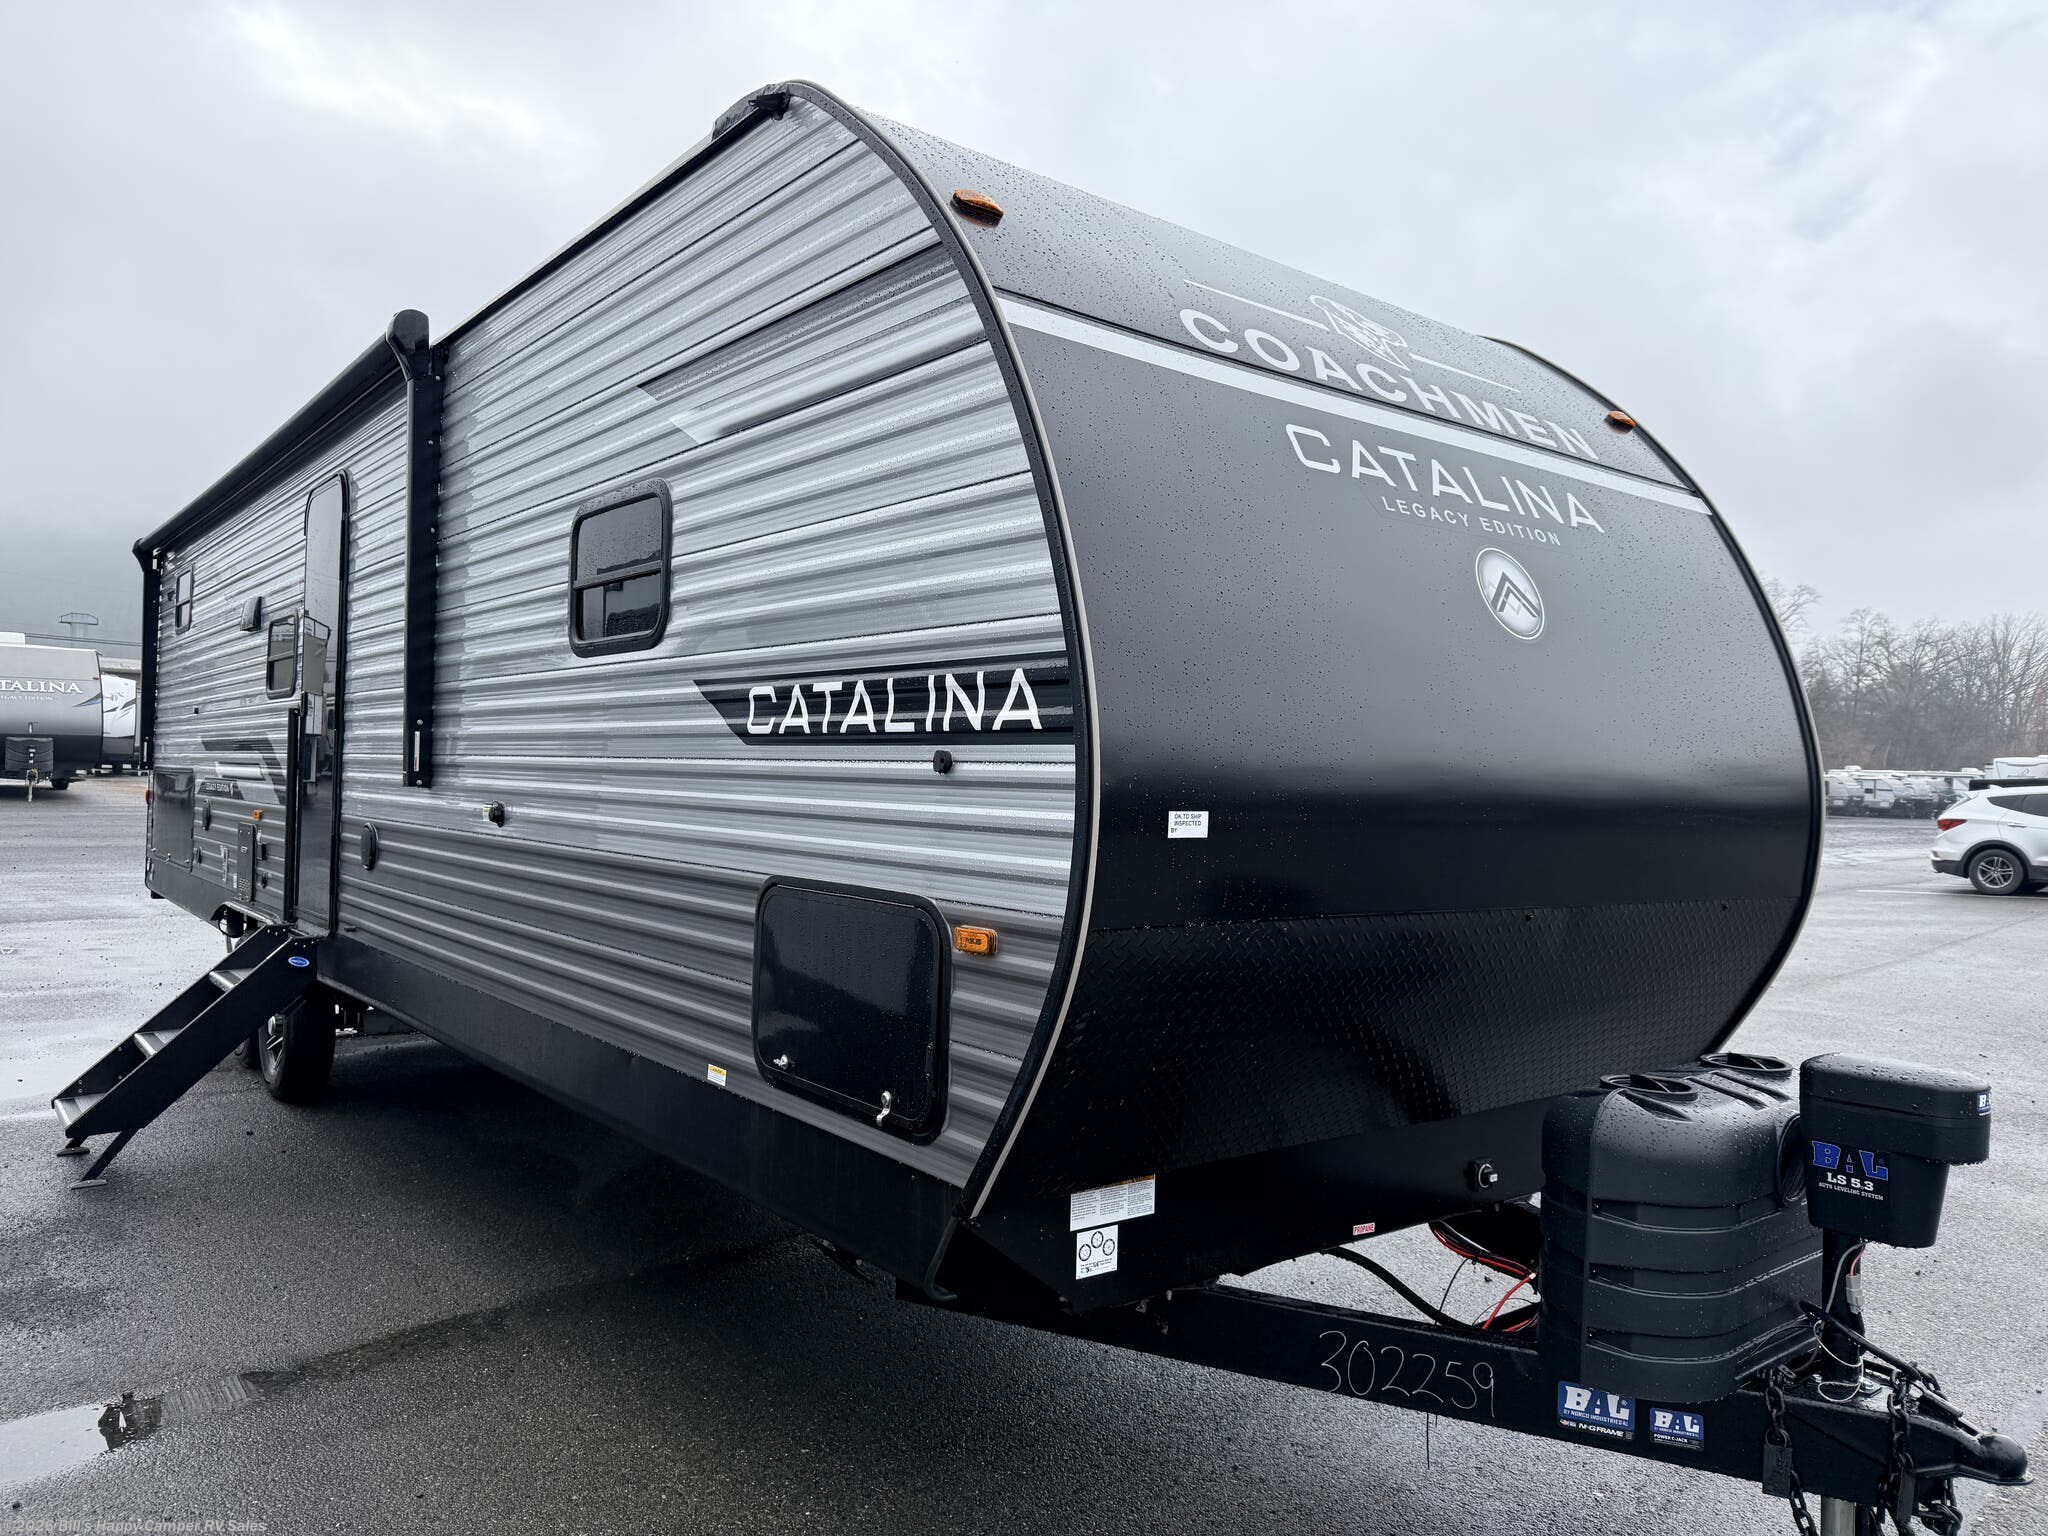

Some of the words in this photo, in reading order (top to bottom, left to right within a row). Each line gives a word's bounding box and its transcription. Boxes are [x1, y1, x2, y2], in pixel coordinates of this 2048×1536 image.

[1179, 308, 1600, 461] COACHMEN
[1285, 423, 1605, 534] CATALINA
[1381, 495, 1470, 528] LEGACY
[1479, 516, 1561, 546] EDITION
[746, 667, 1043, 735] CATALINA
[1811, 1140, 1889, 1181] BAL
[1818, 1181, 1833, 1190] AUTO
[1833, 1184, 1861, 1196] LEVELING
[1861, 1191, 1884, 1201] SYSTEM
[1826, 1172, 1847, 1185] LS
[1850, 1177, 1874, 1192] 5.3
[1354, 1224, 1374, 1234] PROPANE
[1319, 1330, 1495, 1418] 302259
[1564, 1385, 1630, 1420] BAL
[1570, 1410, 1590, 1419] NORCO
[1590, 1413, 1623, 1426] INDUSTRIES
[1654, 1410, 1700, 1433] BAL
